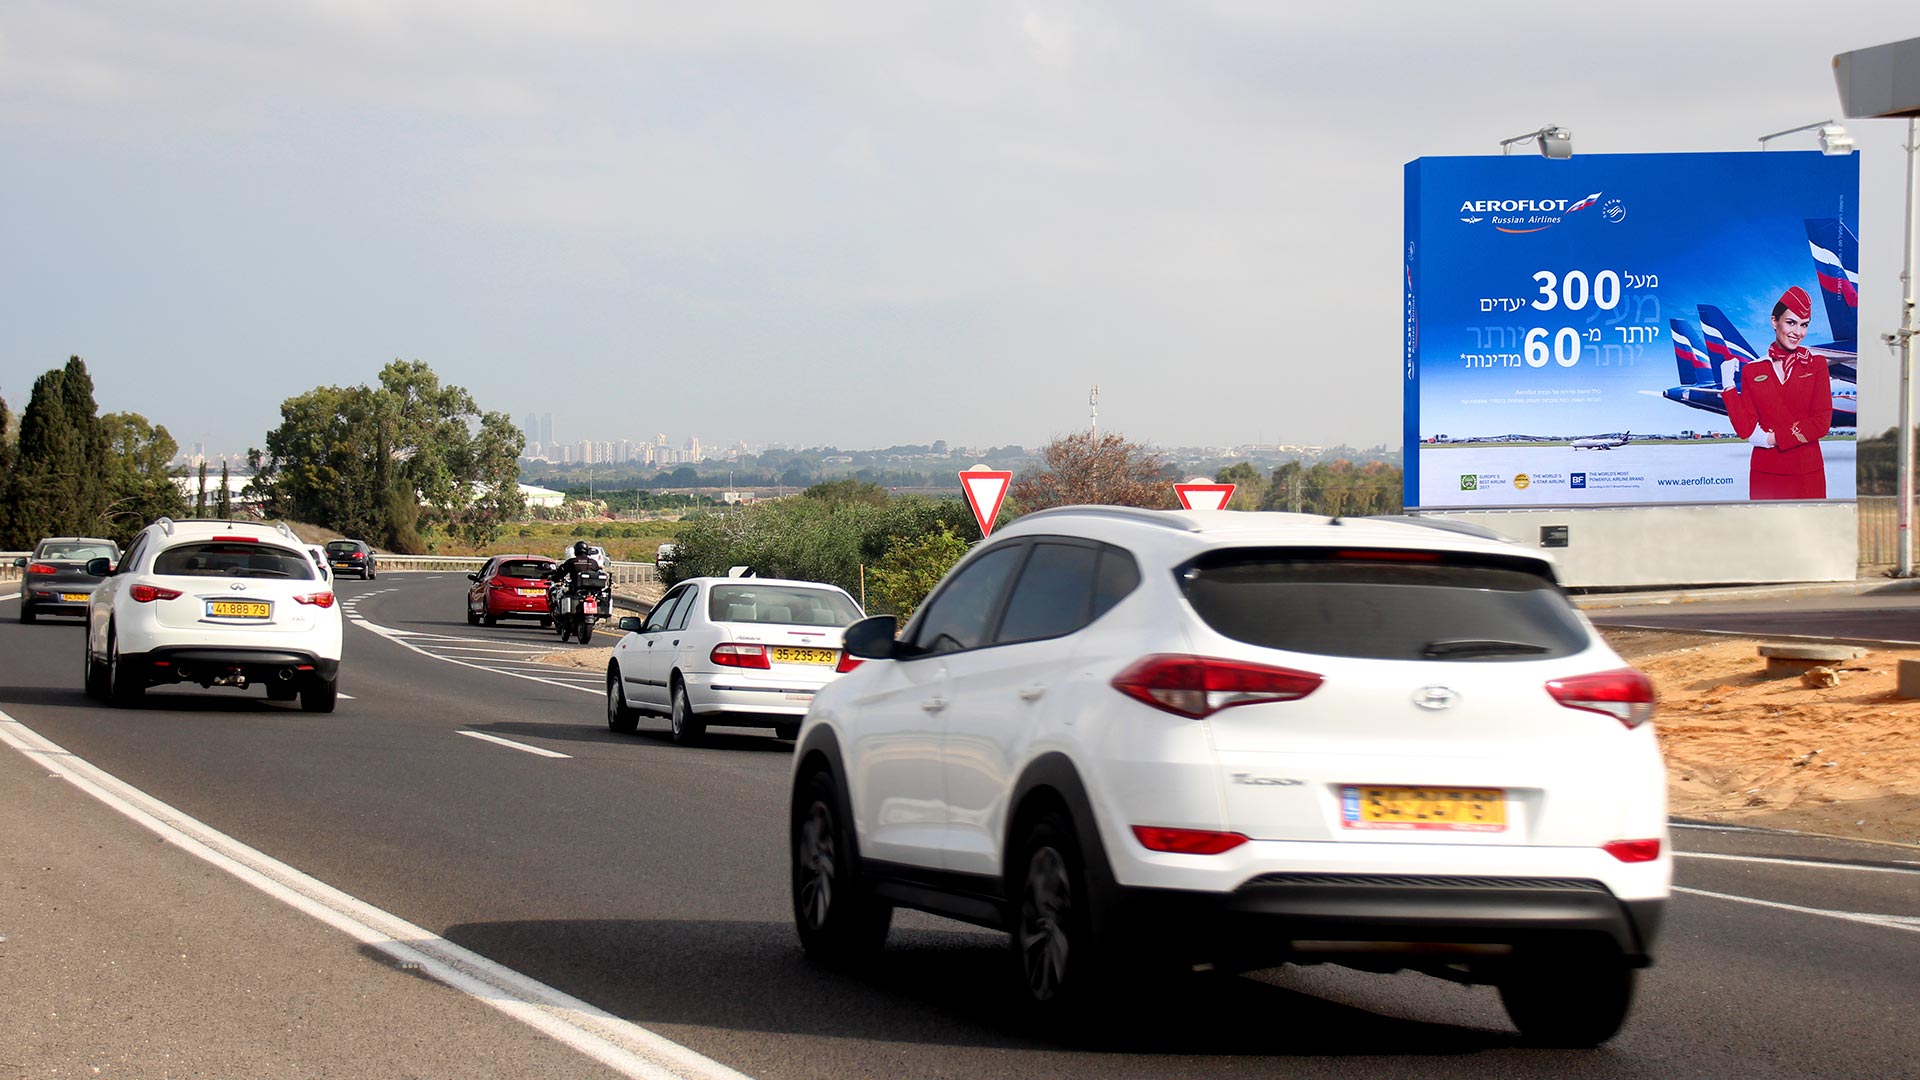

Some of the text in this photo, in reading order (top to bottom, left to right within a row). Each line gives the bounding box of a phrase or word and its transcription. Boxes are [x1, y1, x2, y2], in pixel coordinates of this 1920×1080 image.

[1460, 199, 1568, 212] AEROFLOT
[1491, 215, 1561, 224] Russian Airlines
[1480, 269, 1659, 312] מעל 300 יעדים
[1615, 326, 1660, 344] יותר
[1657, 476, 1734, 486] www.aeroflot.com
